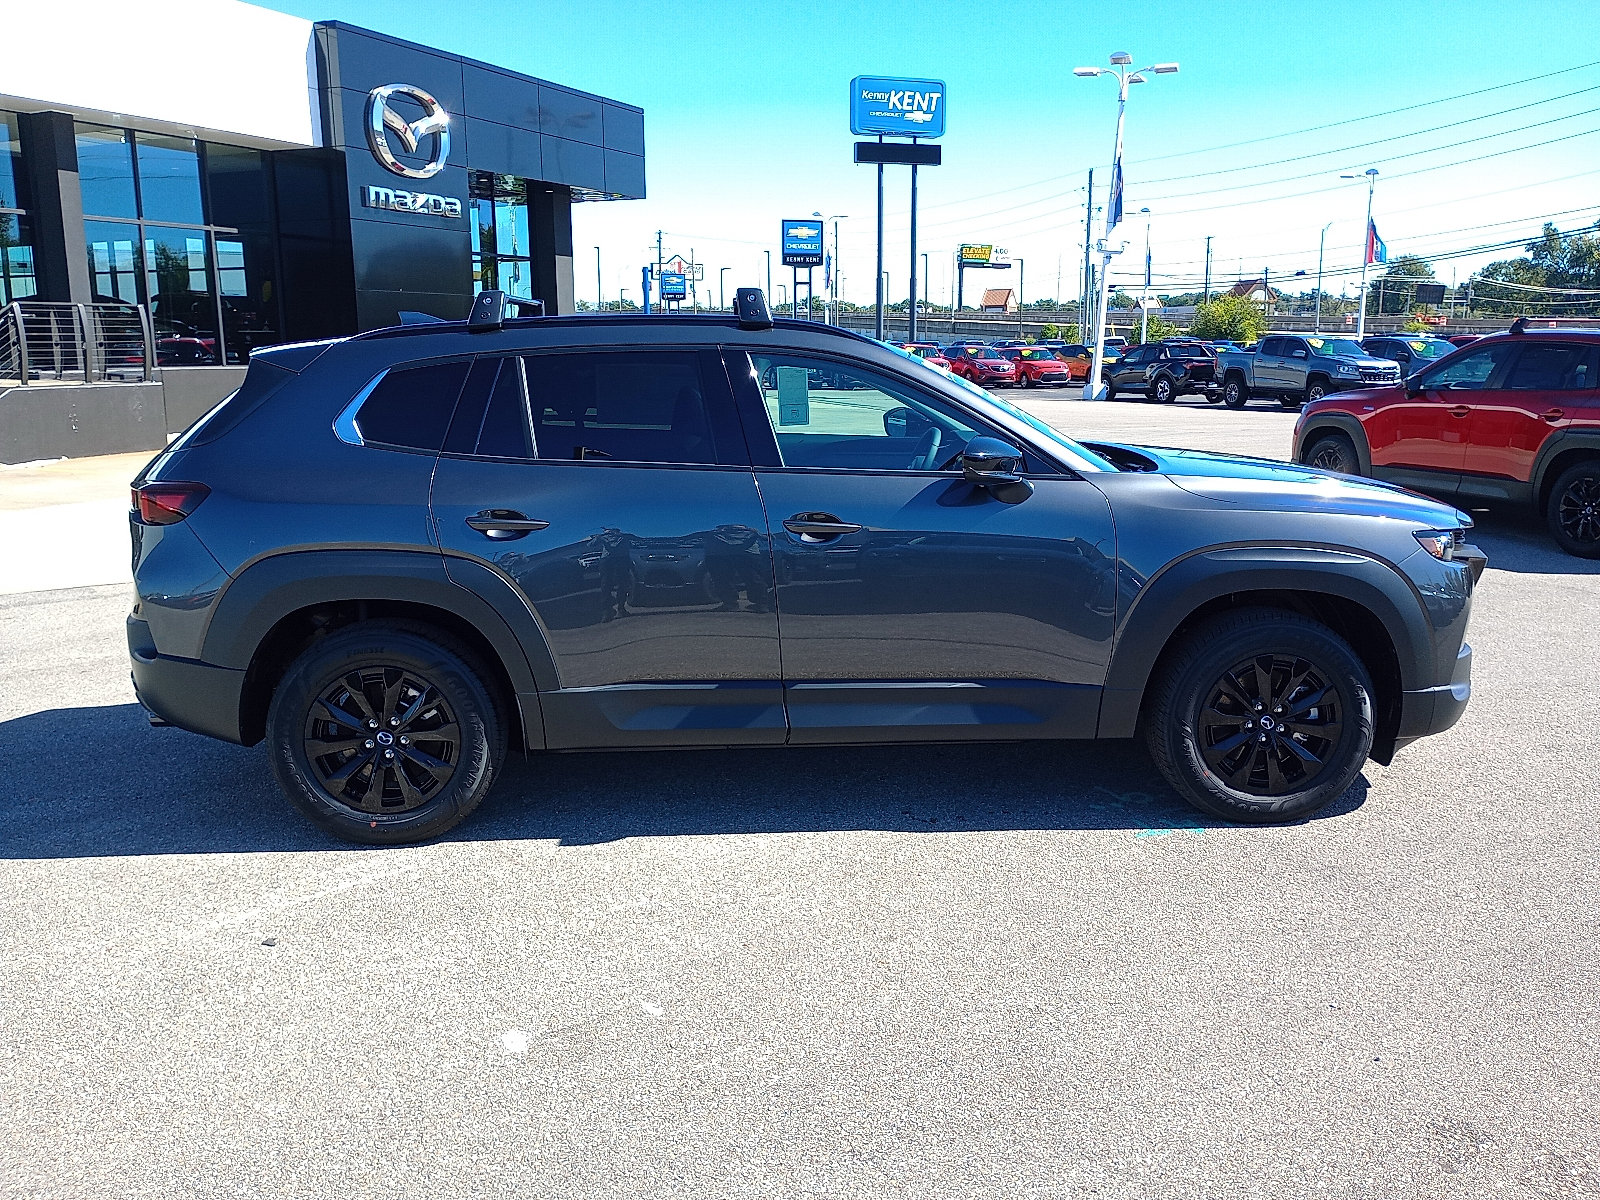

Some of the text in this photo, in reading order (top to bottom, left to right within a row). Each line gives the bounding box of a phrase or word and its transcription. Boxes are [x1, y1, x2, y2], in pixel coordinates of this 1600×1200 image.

[862, 90, 942, 112] Kenny KENT
[361, 185, 462, 218] mazda
